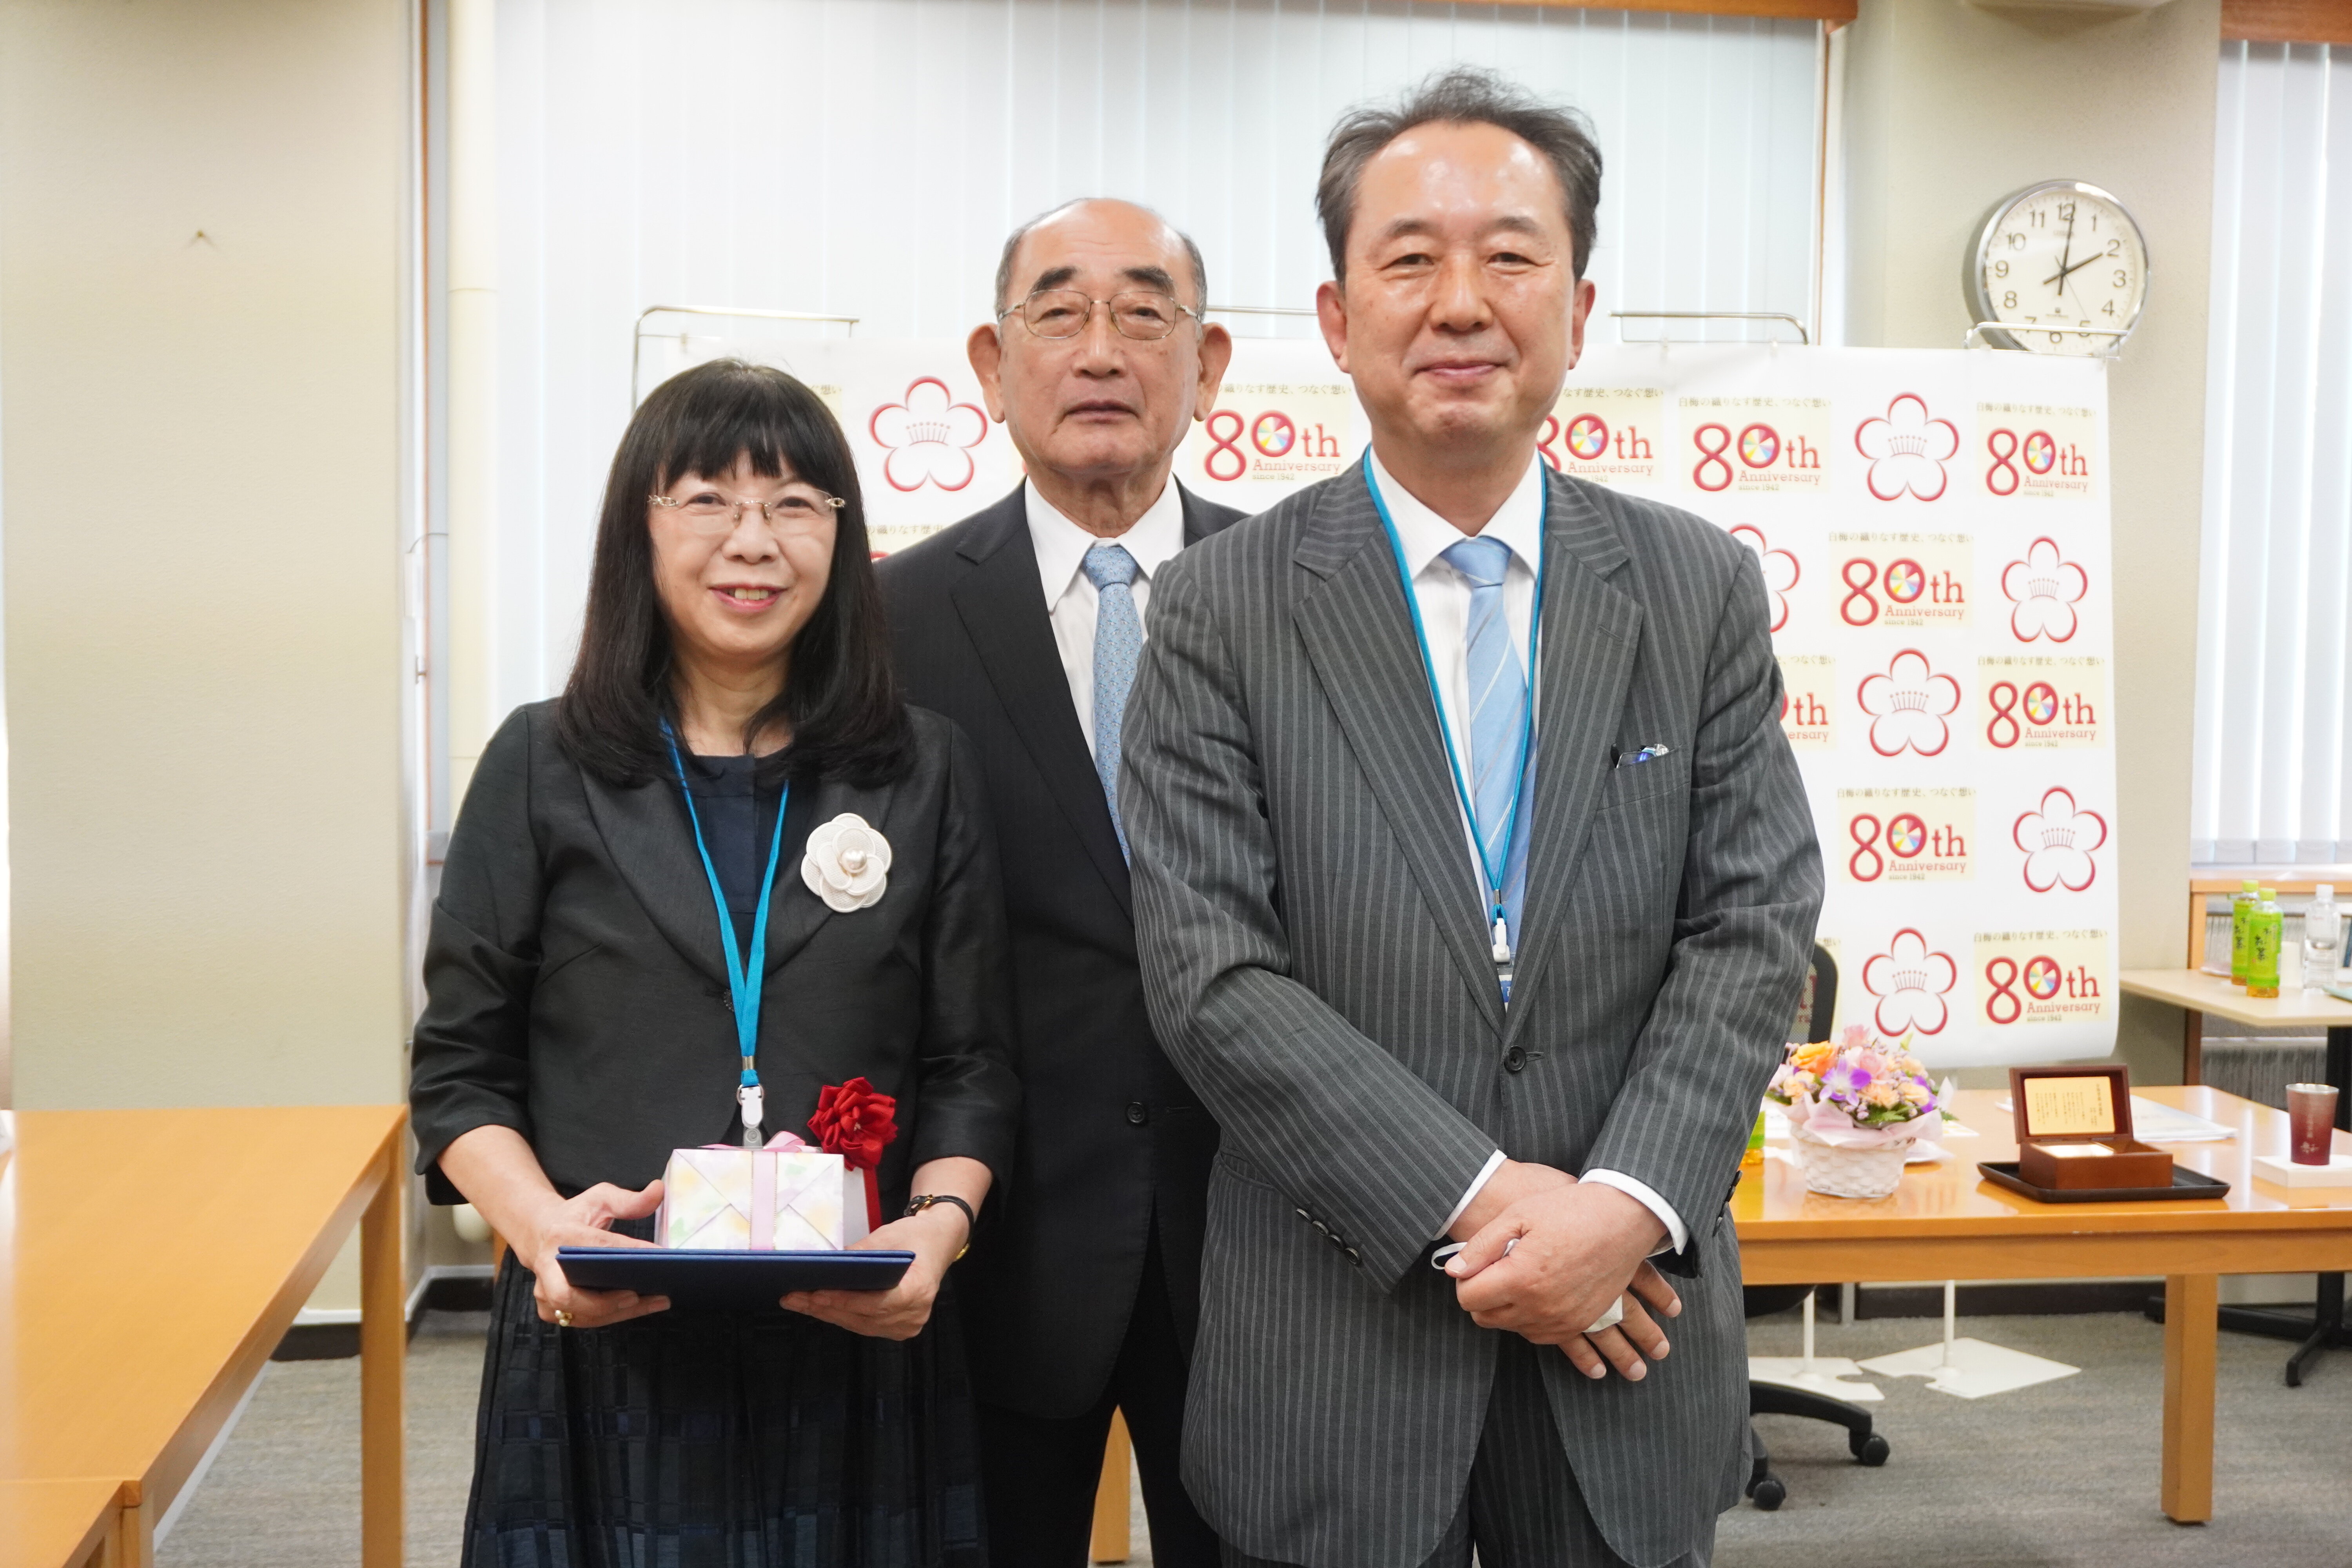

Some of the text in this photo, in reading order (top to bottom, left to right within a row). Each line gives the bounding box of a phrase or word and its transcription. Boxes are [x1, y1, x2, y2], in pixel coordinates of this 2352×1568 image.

[2030, 210, 2045, 227] 11
[2057, 202, 2074, 221] 12
[2091, 214, 2097, 231] 1
[2007, 232, 2026, 250] 10
[2107, 239, 2120, 257] 2
[1995, 261, 2009, 278] 9
[2113, 270, 2126, 288] 3
[2004, 291, 2017, 309] 8
[2102, 299, 2114, 316] 4
[1204, 409, 1341, 481] 80th
[1693, 422, 1820, 492] 80th
[1986, 428, 2088, 496] 80th
[1252, 459, 1341, 474] Anniversary
[1568, 462, 1653, 475] Anniversary
[1739, 470, 1820, 485] Anniversary
[2024, 475, 2088, 492] Anniversary
[1840, 557, 1965, 626] 80th
[1885, 604, 1964, 619] Anniversary
[1987, 681, 2096, 748] 80th
[2025, 727, 2096, 741] Anniversary
[1849, 812, 1967, 882] 80th
[1889, 860, 1966, 873] Anniversary
[1985, 955, 2101, 1024] 80th
[2027, 1001, 2101, 1014] Anniversary
